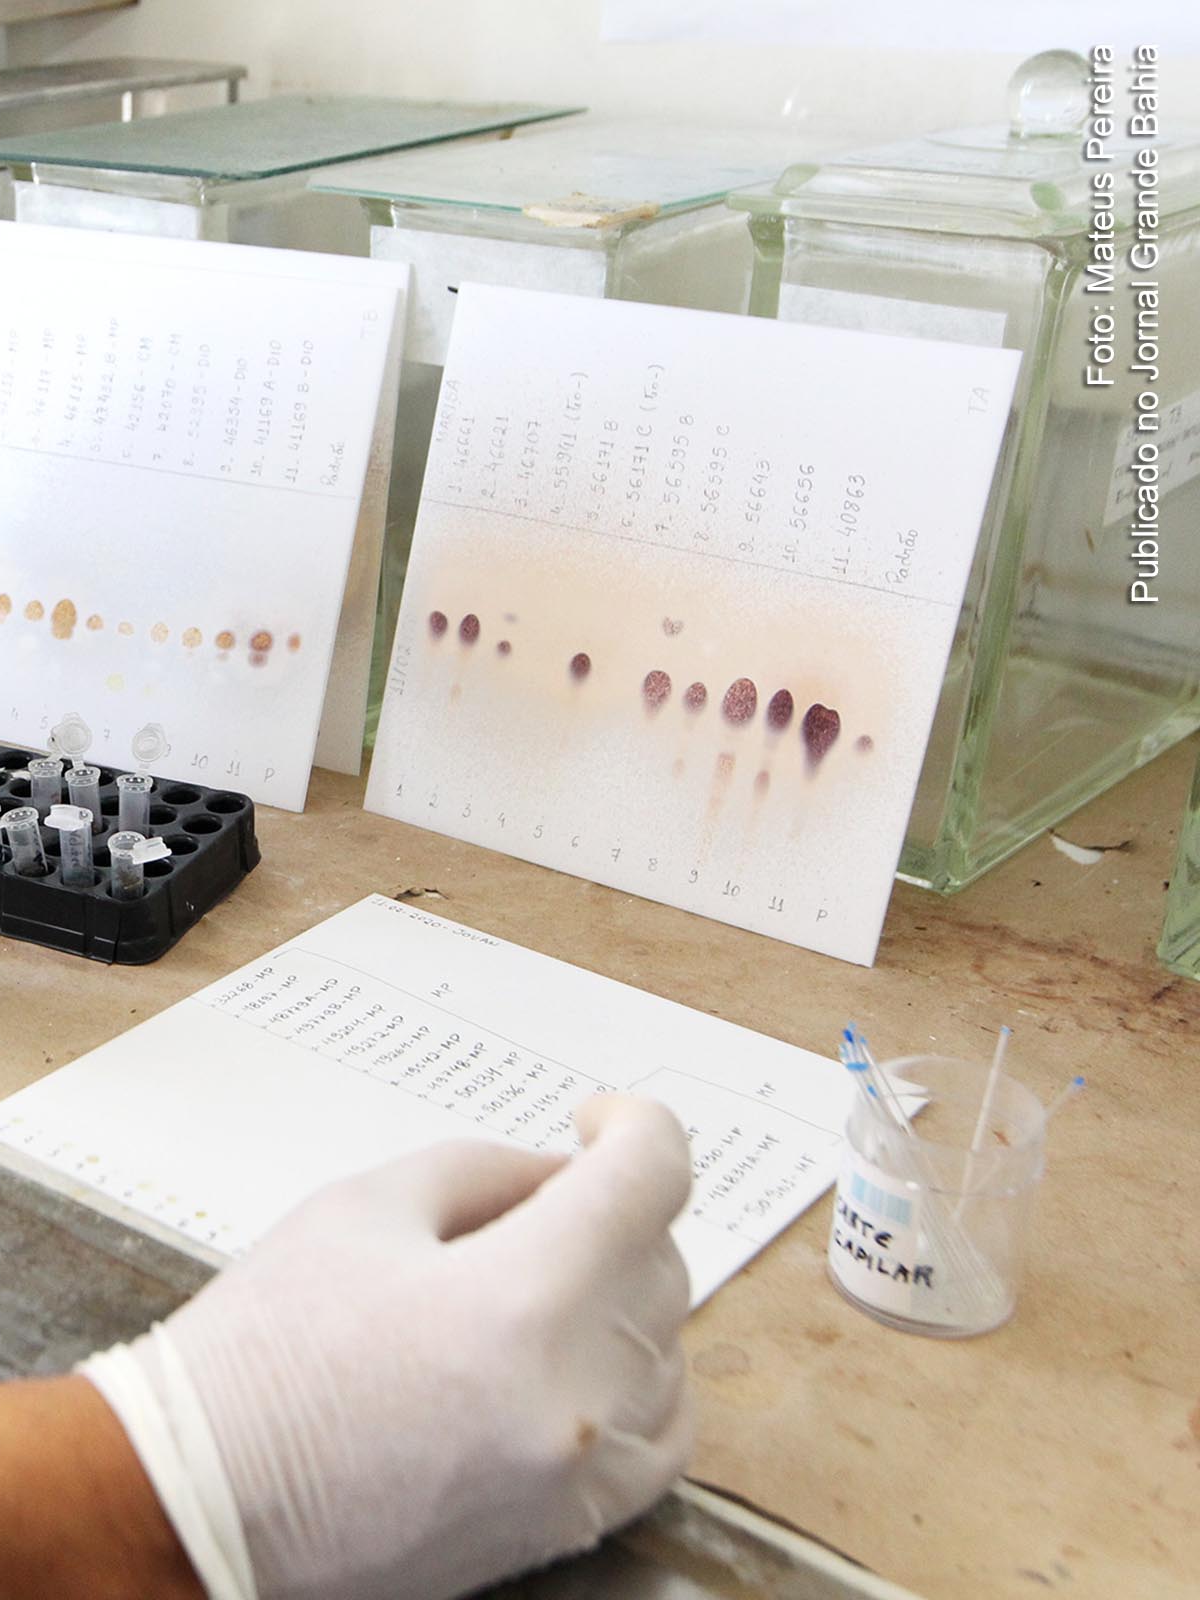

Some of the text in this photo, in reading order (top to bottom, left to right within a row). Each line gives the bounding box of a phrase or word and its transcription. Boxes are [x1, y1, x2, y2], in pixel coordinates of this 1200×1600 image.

[790, 464, 816, 531] 56656
[839, 473, 867, 536] 40863
[191, 753, 209, 769] 10
[226, 761, 241, 776] 11
[428, 794, 439, 808] 2
[462, 802, 472, 819] 3
[497, 812, 506, 828] 4
[532, 823, 543, 840] 5
[570, 835, 580, 849] 6
[610, 847, 621, 863] 7
[647, 858, 658, 872] 8
[688, 868, 699, 884] 9
[721, 880, 740, 897] 10
[768, 895, 784, 912] 11
